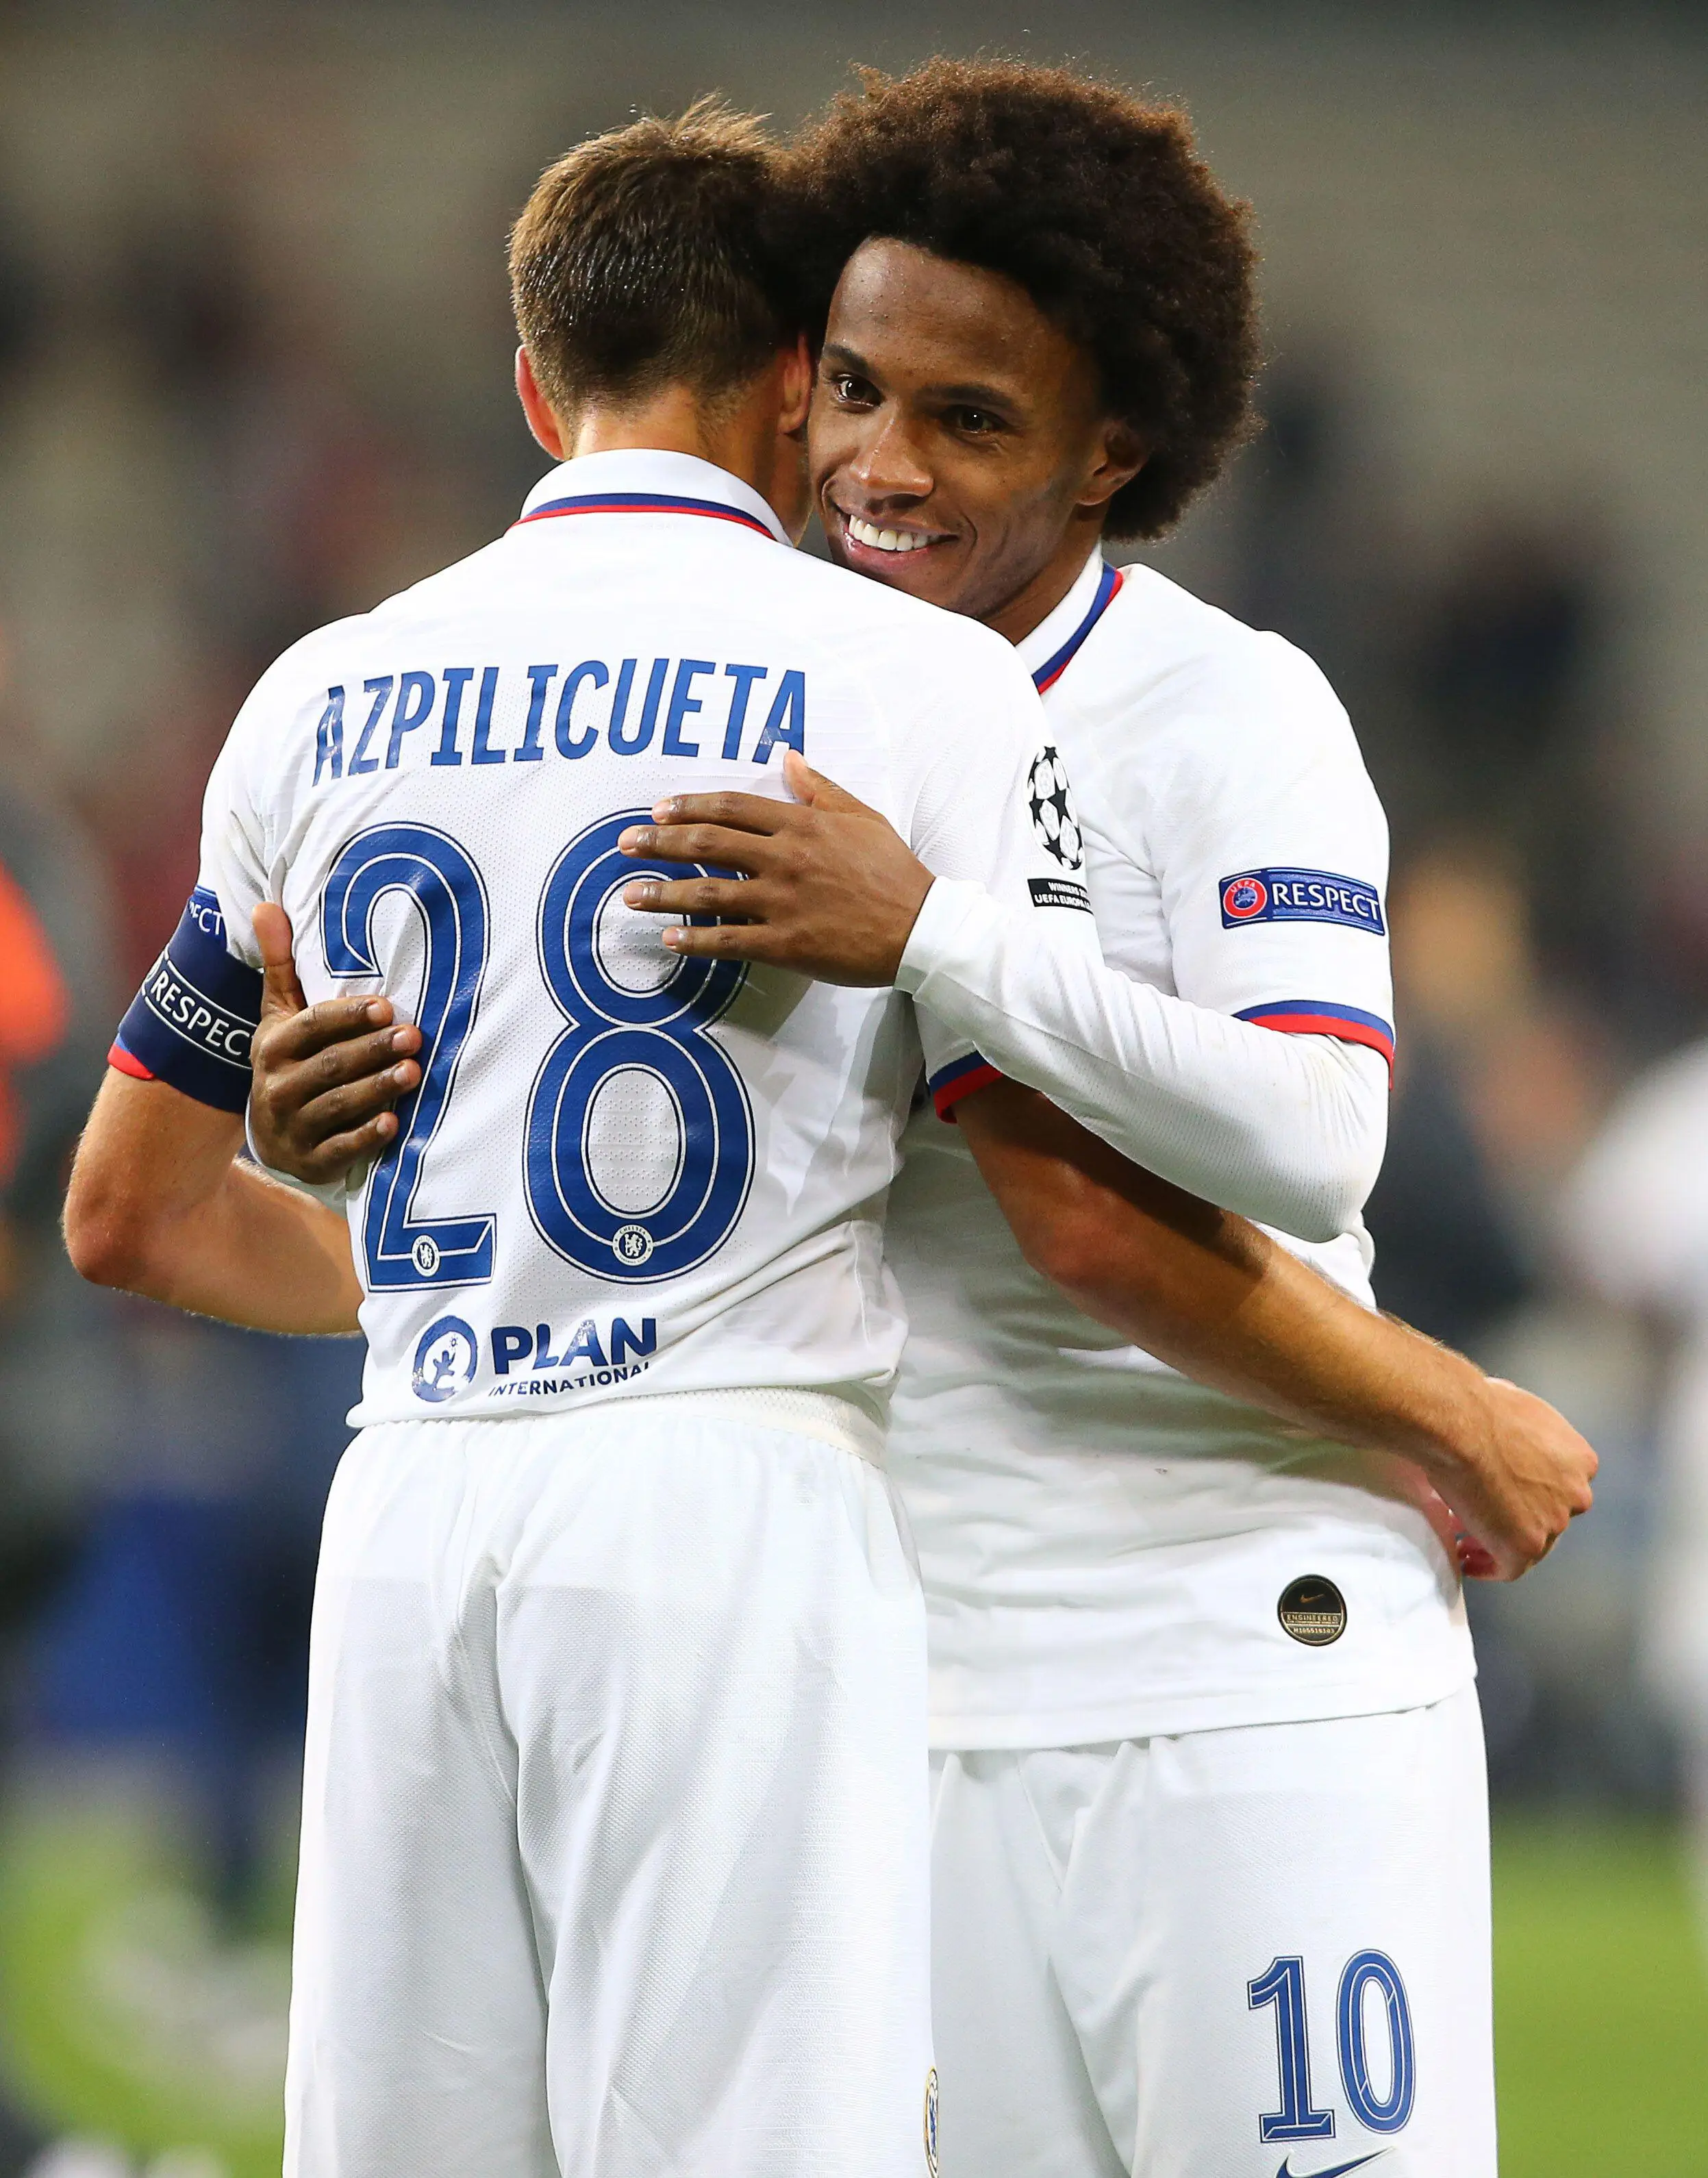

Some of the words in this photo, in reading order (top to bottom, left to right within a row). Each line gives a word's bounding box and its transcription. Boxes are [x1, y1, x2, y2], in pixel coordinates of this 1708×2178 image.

[312, 658, 805, 788] AZPILICUETA
[1034, 894, 1059, 903] UEFA
[1272, 883, 1378, 921] RESPECT
[150, 969, 255, 1055] RESPEC
[319, 807, 757, 1292] 28
[490, 1317, 657, 1375] PLAN
[1247, 1949, 1416, 2143] 10
